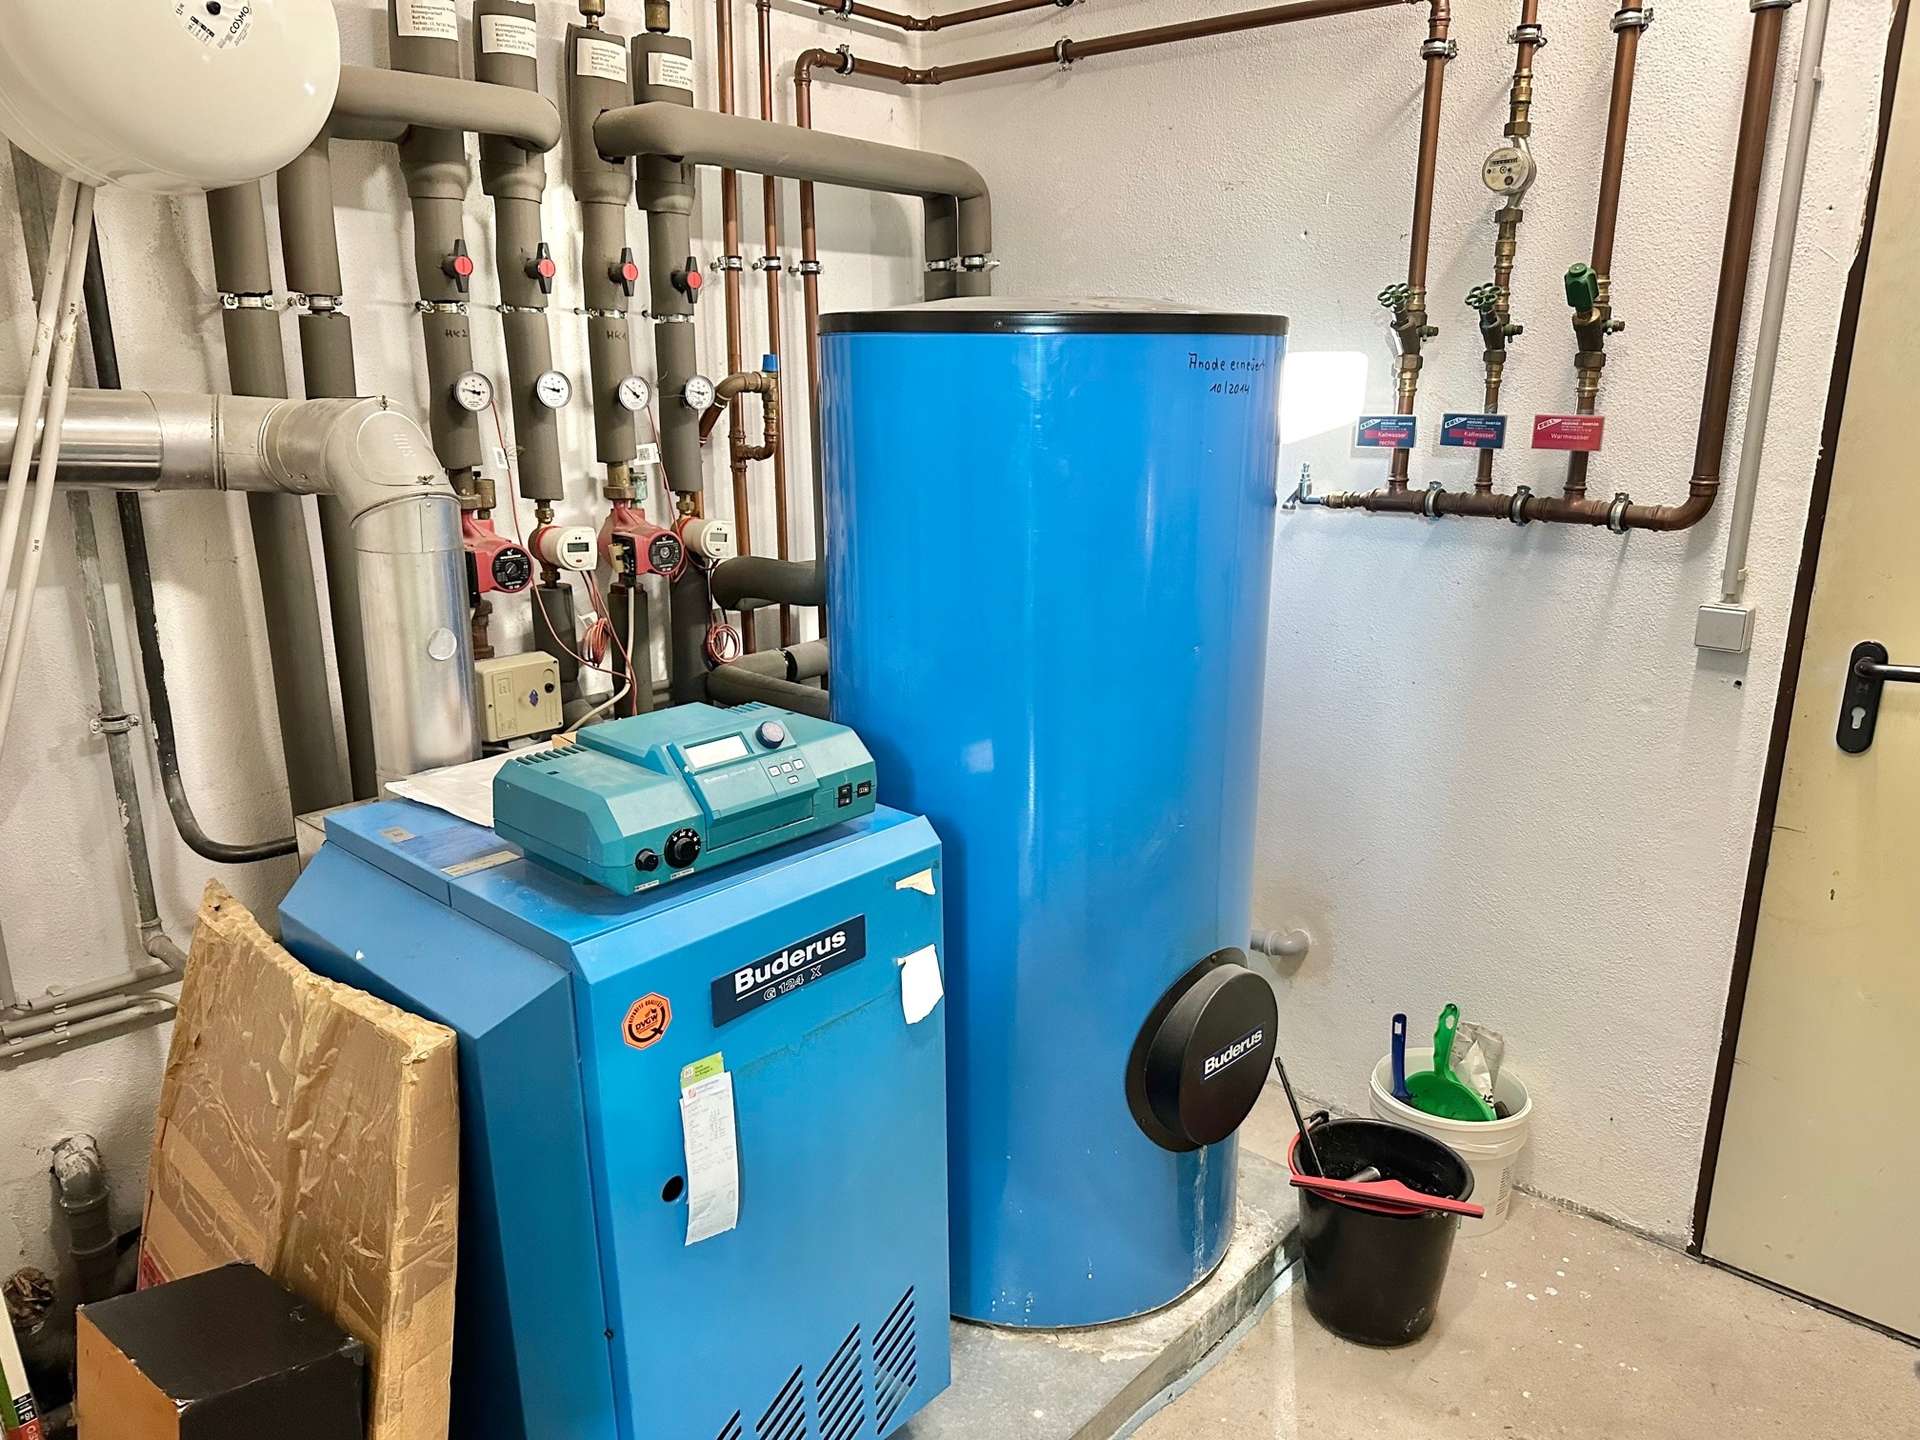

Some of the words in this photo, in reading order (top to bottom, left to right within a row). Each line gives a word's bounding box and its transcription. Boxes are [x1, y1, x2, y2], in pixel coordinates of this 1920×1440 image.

[229, 6, 250, 34] COSMO
[445, 329, 468, 338] HK2
[1188, 352, 1226, 371] Anode
[1209, 380, 1250, 394] 10/2014
[734, 930, 847, 995] Buderus
[778, 973, 805, 994] 124
[810, 965, 823, 980] X
[635, 1014, 658, 1030] DVGW
[1204, 1030, 1263, 1075] Buderus
